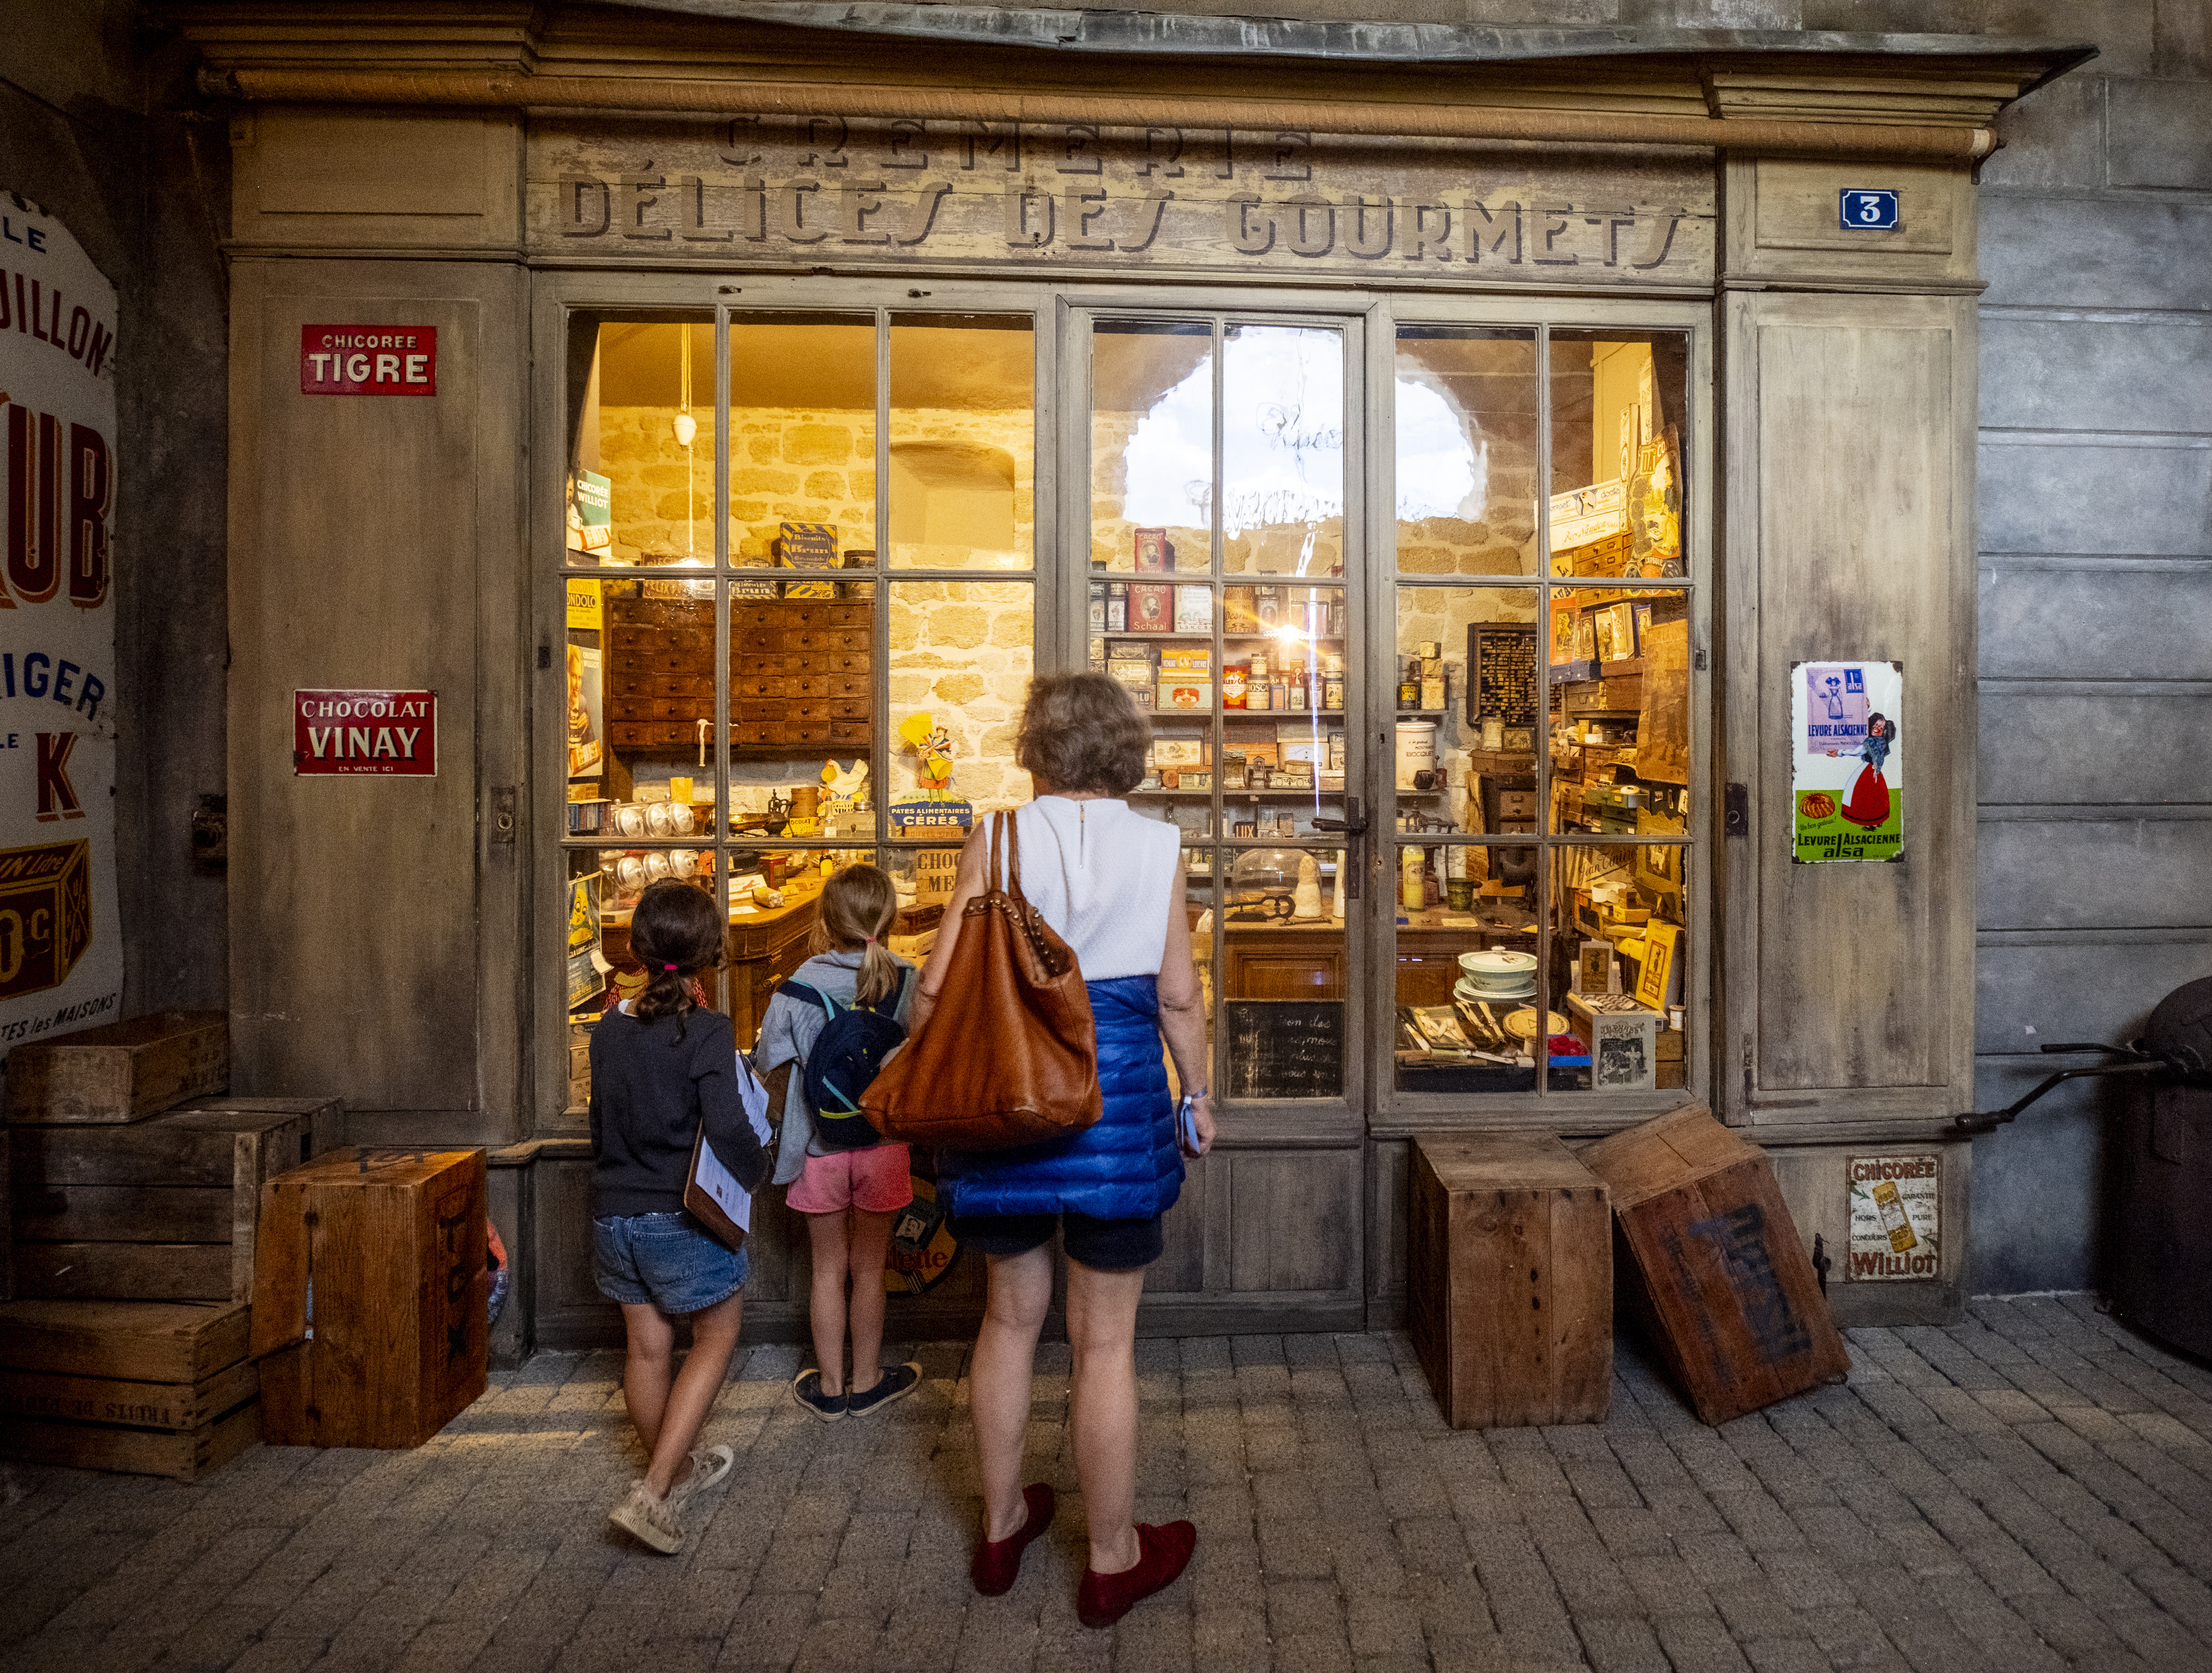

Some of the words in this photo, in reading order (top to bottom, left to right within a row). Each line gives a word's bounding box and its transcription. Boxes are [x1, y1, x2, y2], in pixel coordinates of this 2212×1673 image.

[558, 159, 953, 246] DÉLICES
[1003, 183, 1174, 252] DES
[1228, 191, 1687, 269] GOURMETS
[1861, 196, 1880, 222] 3
[3, 216, 46, 254] LE
[0, 269, 113, 377] UILLON
[321, 335, 417, 349] CHICOREE
[308, 354, 428, 383] TIGRE
[577, 479, 608, 497] CHICORÉE
[0, 393, 112, 609] UB
[577, 491, 608, 509] WILLIOT
[791, 545, 828, 553] Brun
[570, 579, 594, 594] BISCUITS
[567, 593, 597, 608] ONDOLO
[1134, 622, 1166, 630] Schaal
[0, 653, 105, 721] IGER
[1848, 672, 1862, 690] alsa
[301, 700, 429, 719] CHOCOLAT
[1809, 725, 1832, 736] LEVURE
[1833, 725, 1867, 736] ALSACIENNE
[307, 727, 423, 761] VINAY
[0, 733, 18, 748] E
[35, 732, 85, 823] K
[1236, 825, 1254, 838] LUX
[1798, 834, 1836, 846] LEVURE
[1843, 833, 1900, 845] ALSACIENNE
[1824, 834, 1863, 858] alsa
[26, 853, 64, 876] Litre
[929, 876, 955, 892] ME
[31, 1017, 51, 1034] les
[52, 993, 117, 1029] MAISONS
[1854, 1158, 1935, 1181] CHICORÉE
[1852, 1250, 1936, 1275] WILLIOT
[71, 1399, 94, 1416] DE
[105, 1403, 171, 1424] FRUITS
